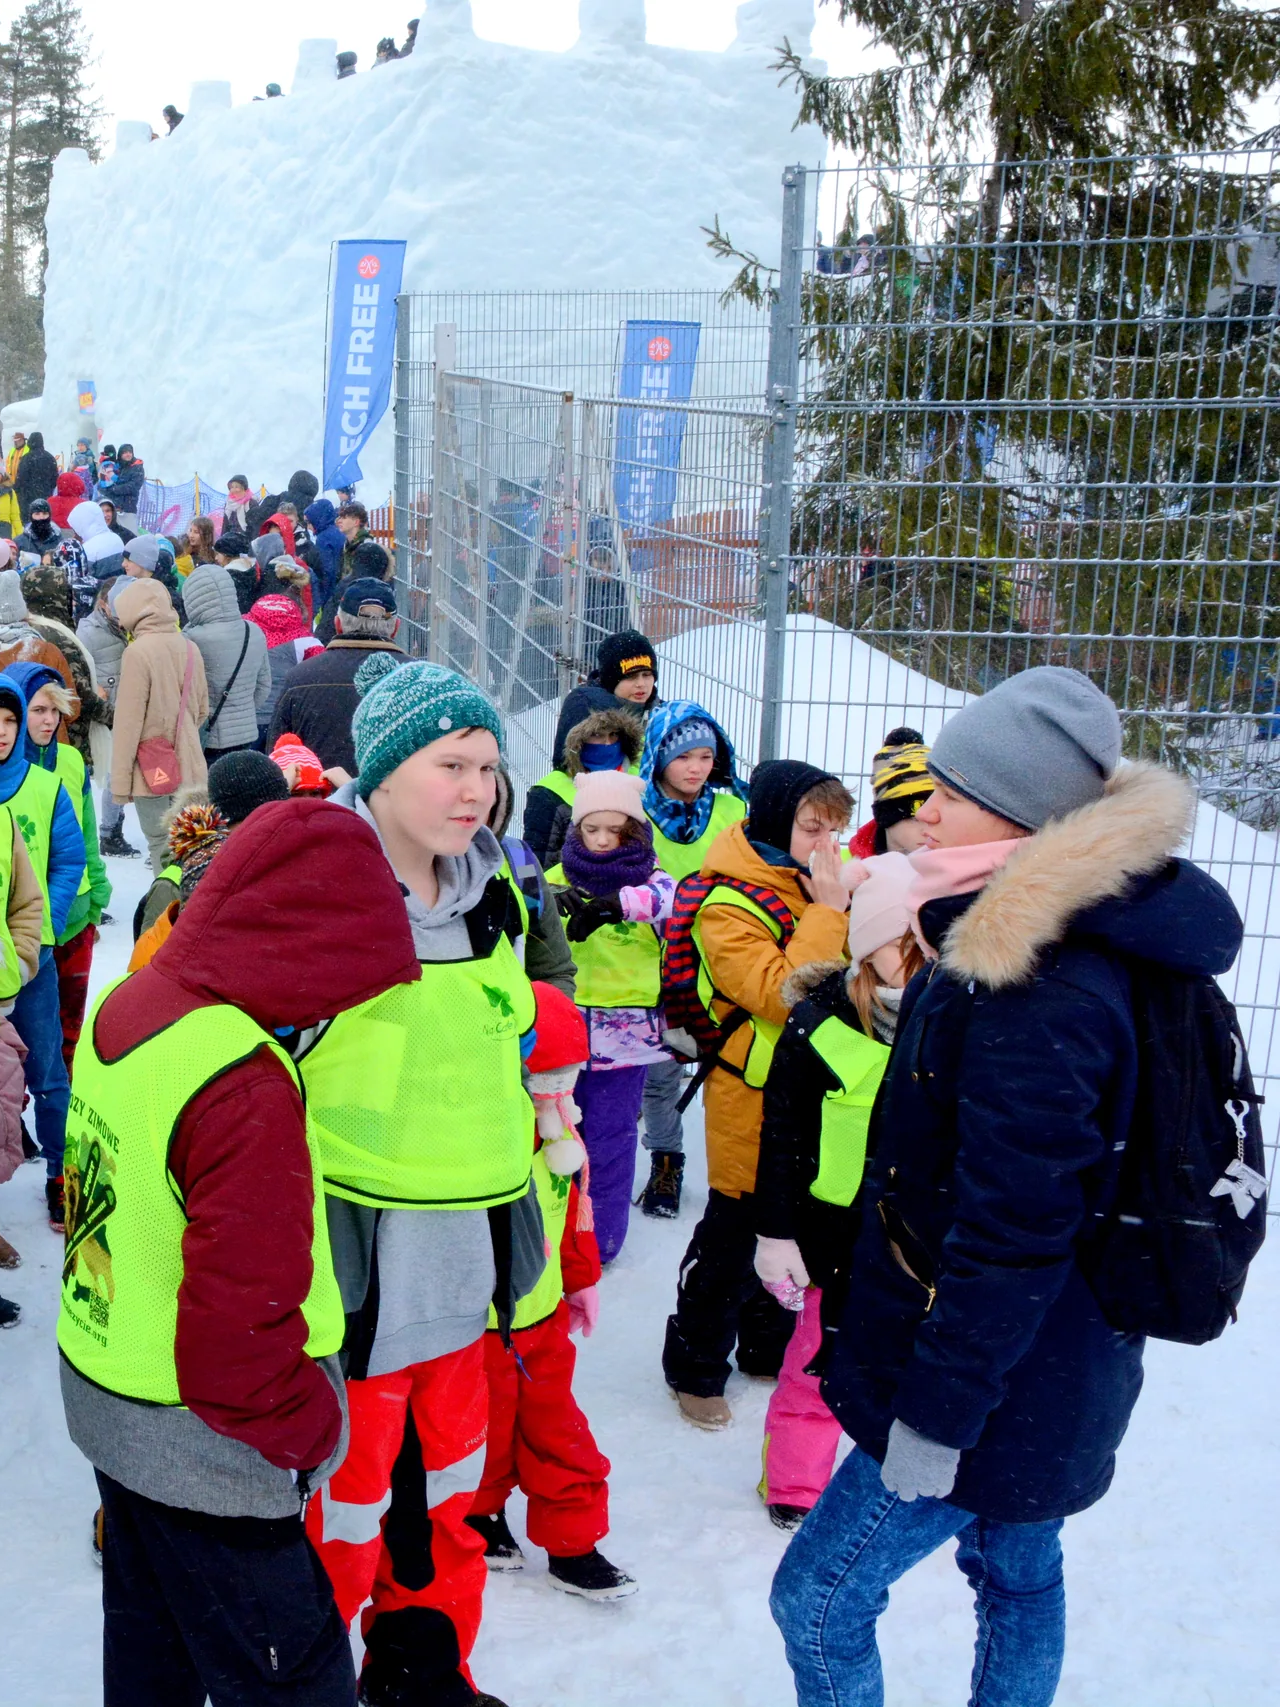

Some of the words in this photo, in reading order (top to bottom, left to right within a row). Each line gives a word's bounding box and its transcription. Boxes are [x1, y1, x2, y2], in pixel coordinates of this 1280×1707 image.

[346, 283, 380, 375] FREE
[340, 386, 370, 456] ECH
[87, 1106, 120, 1155] ZIMOWE
[83, 1160, 95, 1197] SPORT
